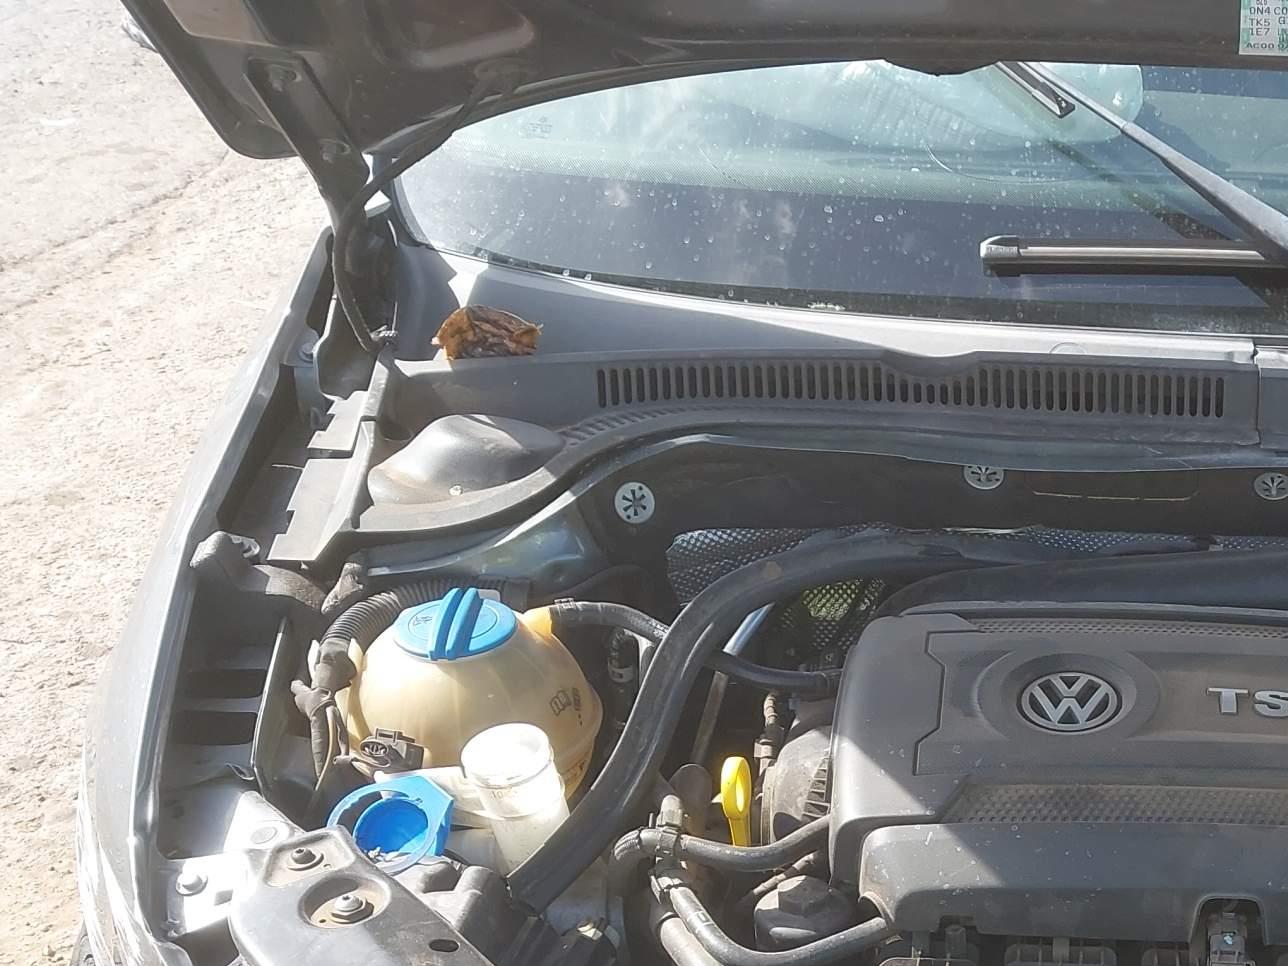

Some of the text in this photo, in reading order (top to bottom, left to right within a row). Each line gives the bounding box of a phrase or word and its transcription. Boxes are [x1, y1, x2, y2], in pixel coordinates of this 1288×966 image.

[1249, 18, 1271, 26] TK5
[1249, 28, 1270, 36] 1E7
[1021, 671, 1118, 731] VW
